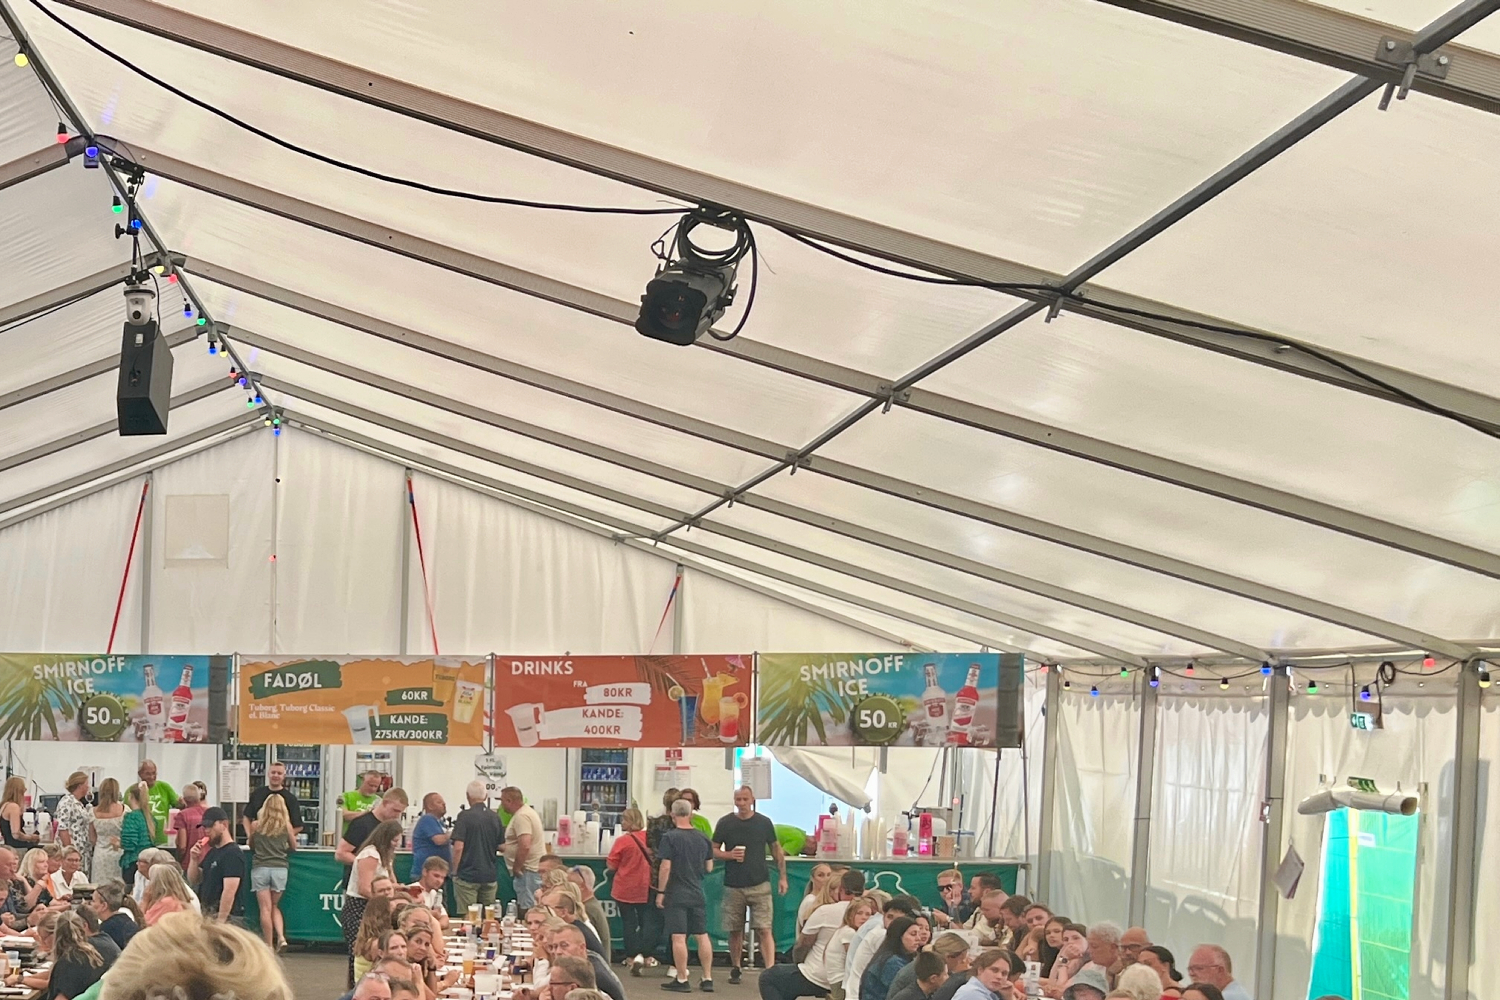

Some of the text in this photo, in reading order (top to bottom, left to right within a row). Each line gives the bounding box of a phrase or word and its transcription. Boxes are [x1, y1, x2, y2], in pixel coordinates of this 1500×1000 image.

[33, 655, 125, 680] SMIRNOFF
[511, 660, 574, 675] DRINKS
[800, 655, 904, 682] SMIRNOFF
[67, 677, 95, 695] ICE
[263, 672, 322, 689] FADØL
[573, 680, 588, 688] FRA
[603, 687, 633, 698] 80KR
[838, 678, 869, 697] ICE
[401, 690, 428, 701] 60KR
[280, 703, 308, 714] Tuborg
[308, 703, 336, 712] Classic
[582, 708, 625, 719] KANDE:
[86, 706, 111, 725] 50
[389, 715, 429, 725] KANDE:
[859, 709, 898, 729] 50 KR
[374, 729, 443, 740] 275KR/300KR
[584, 725, 621, 735] 400KR
